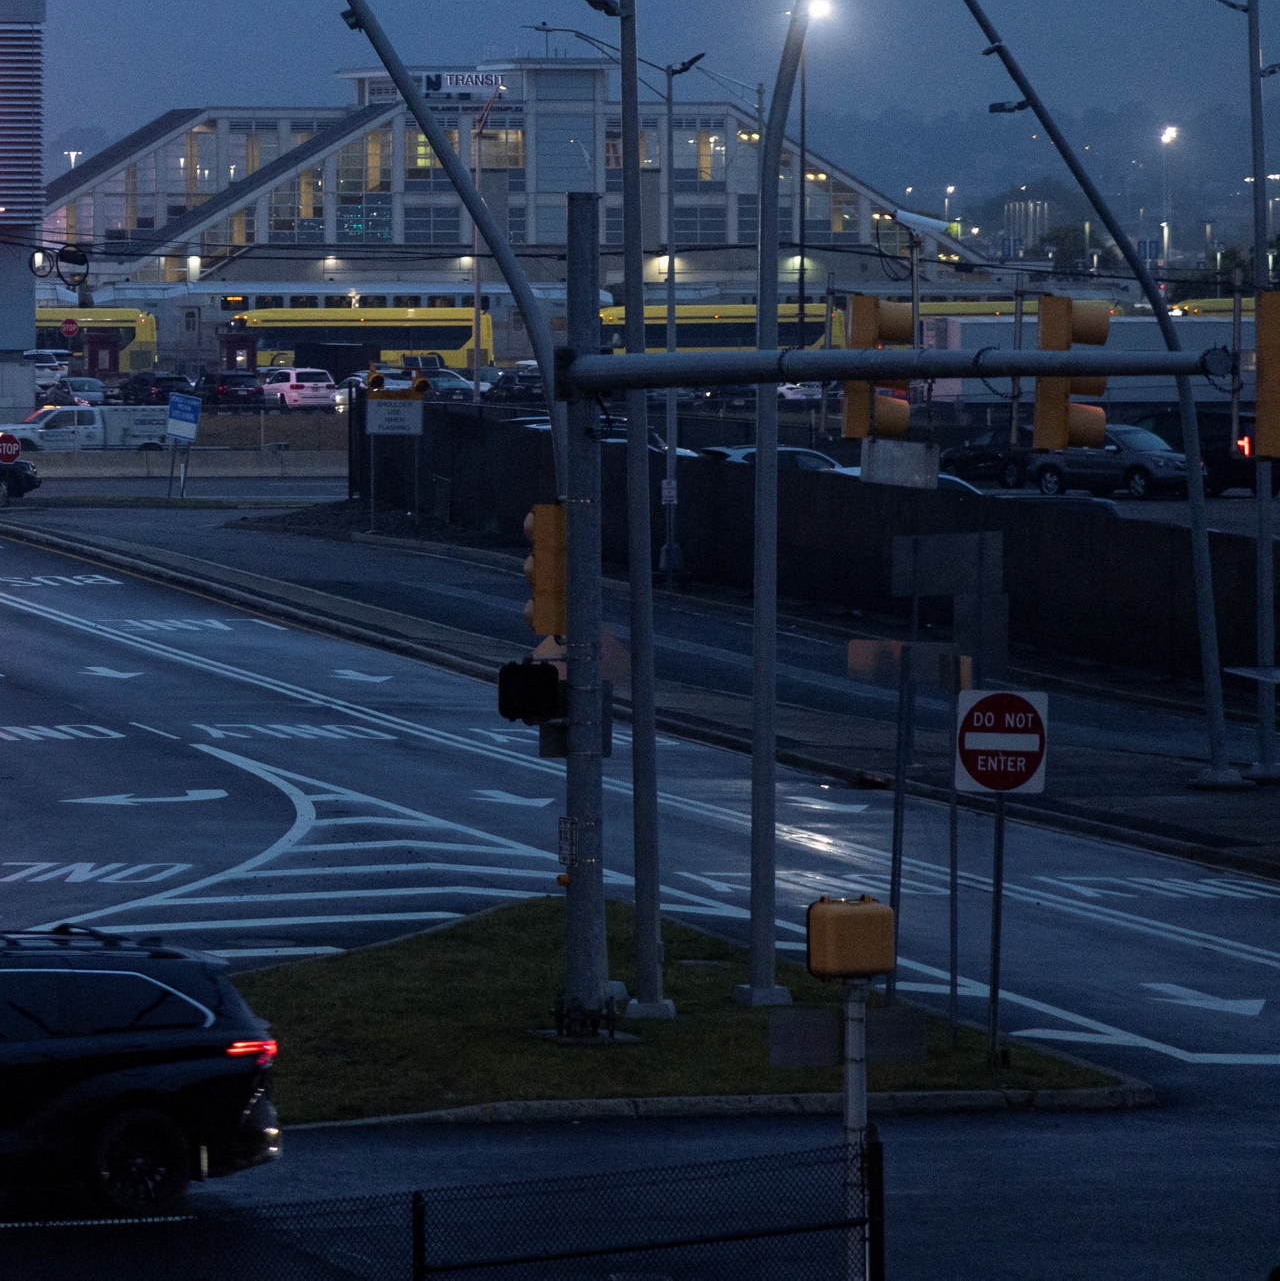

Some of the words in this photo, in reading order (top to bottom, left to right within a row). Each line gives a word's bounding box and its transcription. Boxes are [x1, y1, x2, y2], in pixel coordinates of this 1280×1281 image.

[447, 73, 505, 87] TRANSIT
[61, 322, 78, 332] STOP
[972, 710, 996, 729] DO
[1003, 712, 1035, 730] NOT
[191, 723, 399, 740] ONLY
[977, 755, 1027, 773] ENTER
